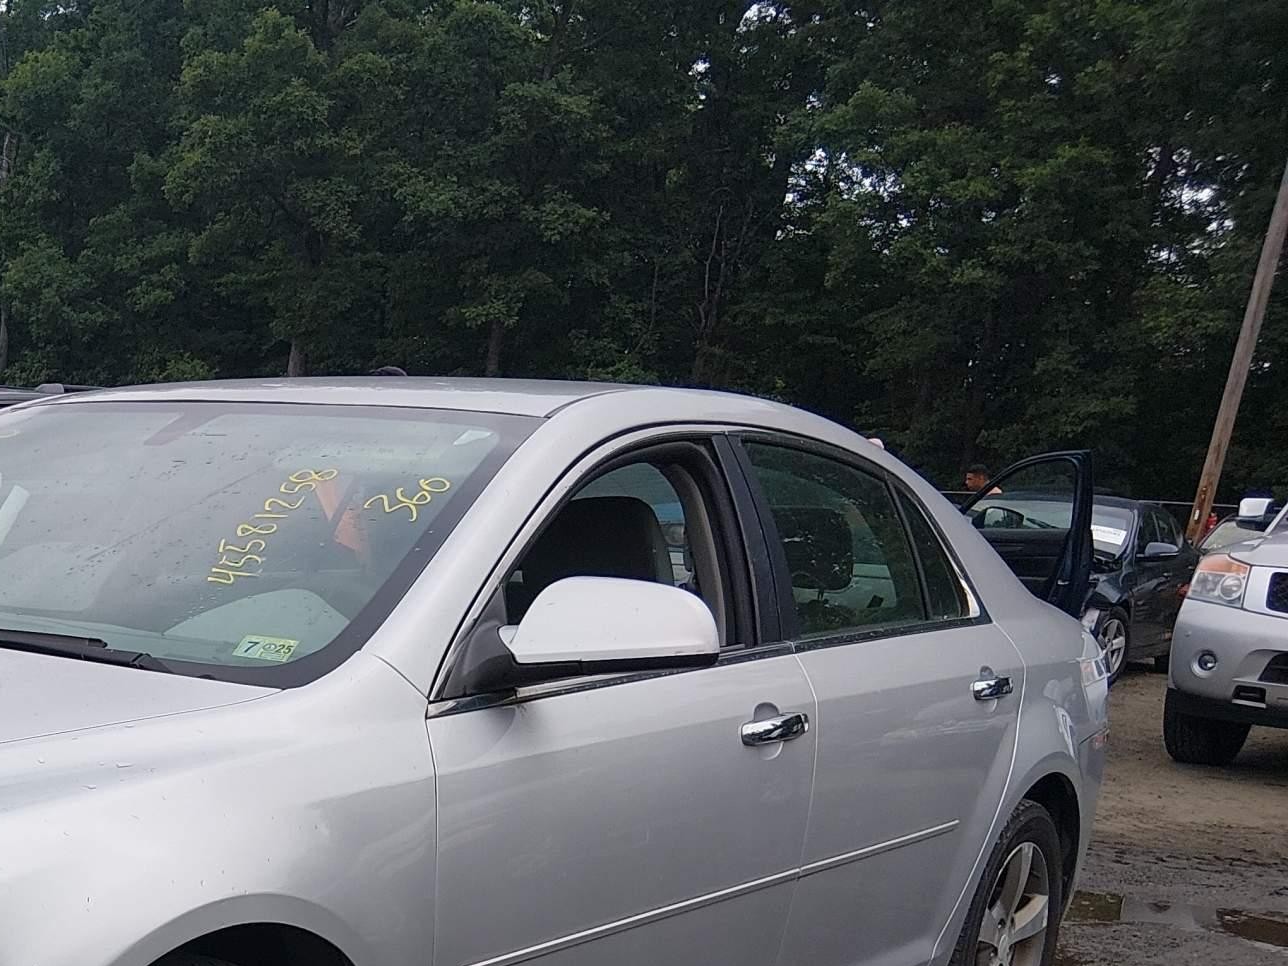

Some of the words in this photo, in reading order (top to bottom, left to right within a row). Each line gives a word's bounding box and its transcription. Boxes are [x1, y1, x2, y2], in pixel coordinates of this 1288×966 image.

[363, 476, 450, 522] 360
[207, 468, 338, 584] 45581258
[243, 640, 260, 653] 7
